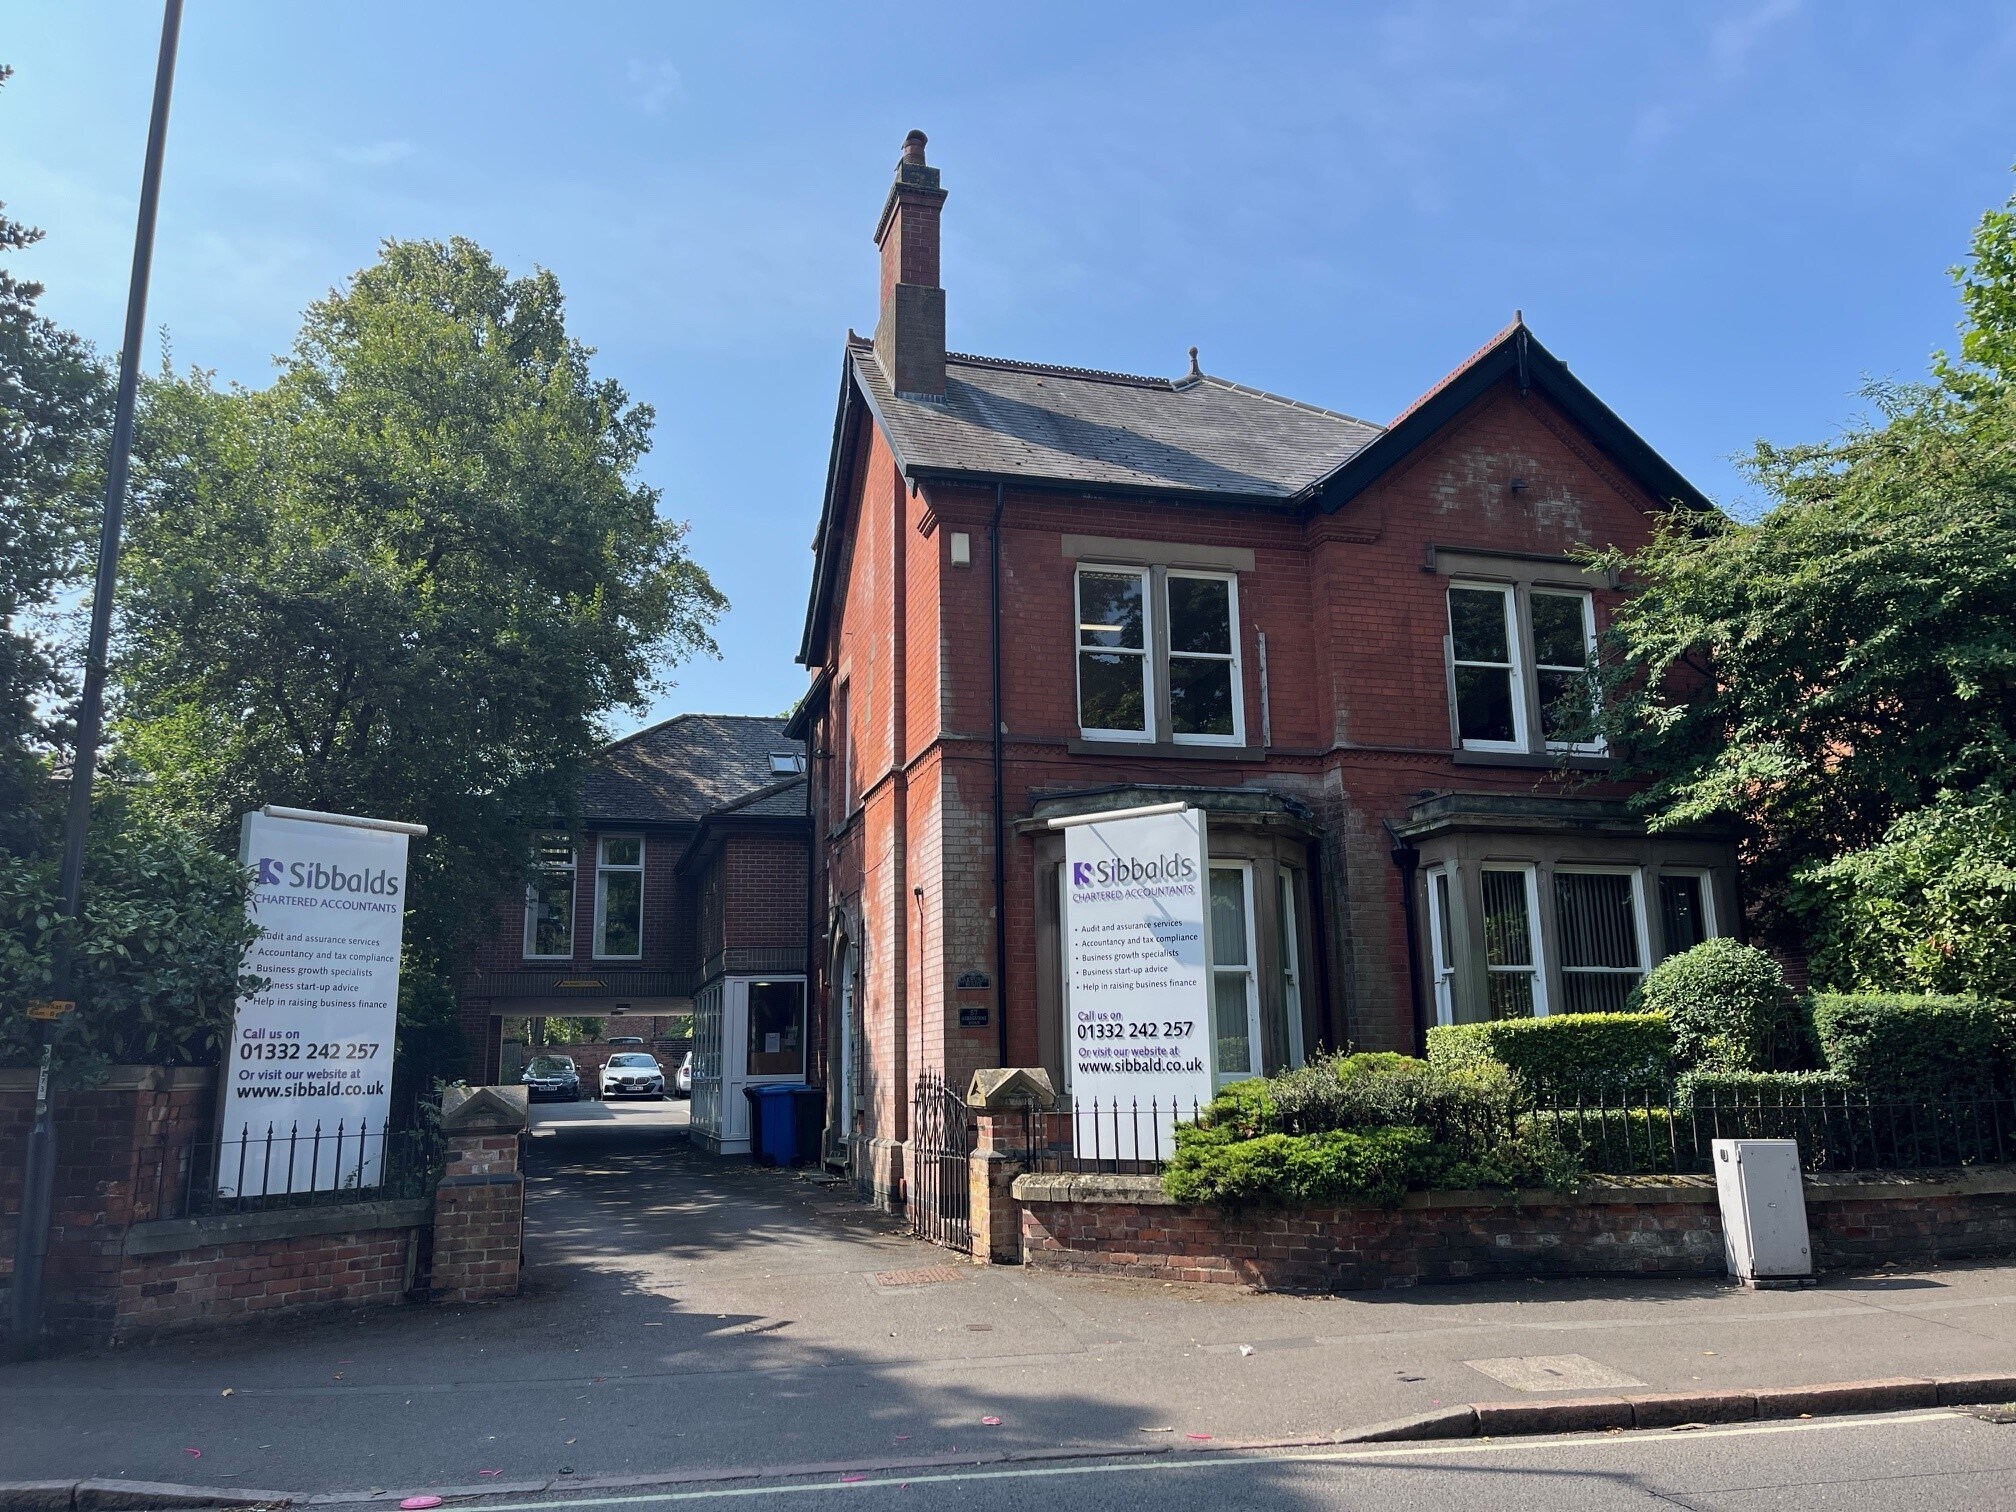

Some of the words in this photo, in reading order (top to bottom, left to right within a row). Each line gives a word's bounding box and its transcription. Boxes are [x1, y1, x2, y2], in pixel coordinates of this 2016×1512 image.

[1097, 853, 1192, 883] Sibbalds
[289, 862, 399, 896] Sibbalds
[1072, 889, 1121, 902] CHARTERED
[1125, 885, 1194, 897] ACCOUNTANTS
[254, 893, 318, 908] CHARTERED
[320, 899, 397, 914] ACCOUNTANTS
[1081, 925, 1101, 933] Audit
[1102, 924, 1115, 932] and
[1116, 922, 1152, 931] assurance
[1153, 920, 1183, 928] services
[286, 933, 303, 942] and
[305, 935, 346, 944] assurance
[348, 937, 380, 946] services
[1082, 938, 1125, 947] Accountancy
[1127, 937, 1141, 945] and
[1142, 936, 1154, 944] tax
[1156, 934, 1198, 944] compliance
[257, 948, 314, 960] Accountancy
[316, 951, 332, 959] and
[334, 952, 347, 960] tax
[349, 952, 394, 963] compliance
[1082, 954, 1112, 962] Business
[1114, 951, 1140, 962] growth
[1141, 949, 1179, 959] specialists
[256, 964, 296, 974] Business
[297, 965, 328, 976] growth
[330, 967, 373, 977] specialists
[1082, 968, 1113, 976] Business
[1114, 967, 1143, 975] start-up
[1144, 965, 1168, 973] advice
[296, 982, 331, 993] start-up
[332, 983, 359, 992] advice
[1082, 983, 1100, 992] Help
[1101, 982, 1108, 990] in
[1109, 981, 1134, 990] raising
[1135, 980, 1168, 988] business
[1169, 979, 1197, 987] finance
[253, 997, 274, 1008] Help
[277, 998, 286, 1006] in
[288, 998, 318, 1009] raising
[320, 999, 356, 1008] business
[358, 999, 388, 1009] finance
[1077, 1011, 1095, 1021] Call
[1097, 1012, 1108, 1020] us
[1110, 1012, 1122, 1020] on
[243, 1028, 266, 1039] Call
[269, 1030, 282, 1039] us
[285, 1030, 300, 1039] on
[1077, 1023, 1124, 1039] 01332
[1129, 1022, 1157, 1038] 242
[1163, 1021, 1193, 1037] 257
[240, 1042, 300, 1060] 01332
[306, 1043, 341, 1060] 242
[345, 1043, 380, 1060] 257
[1078, 1048, 1091, 1057] Or
[1092, 1047, 1111, 1057] visit
[1113, 1048, 1128, 1056] our
[1131, 1046, 1167, 1056] website
[1169, 1046, 1179, 1056] at
[1078, 1057, 1202, 1072] www.sibbald.co.uk
[239, 1069, 255, 1080] Or
[258, 1069, 282, 1080] visit
[285, 1071, 304, 1080] our
[306, 1068, 348, 1079] website
[350, 1069, 361, 1079] at
[237, 1080, 384, 1098] www.sibbald.co.uk
